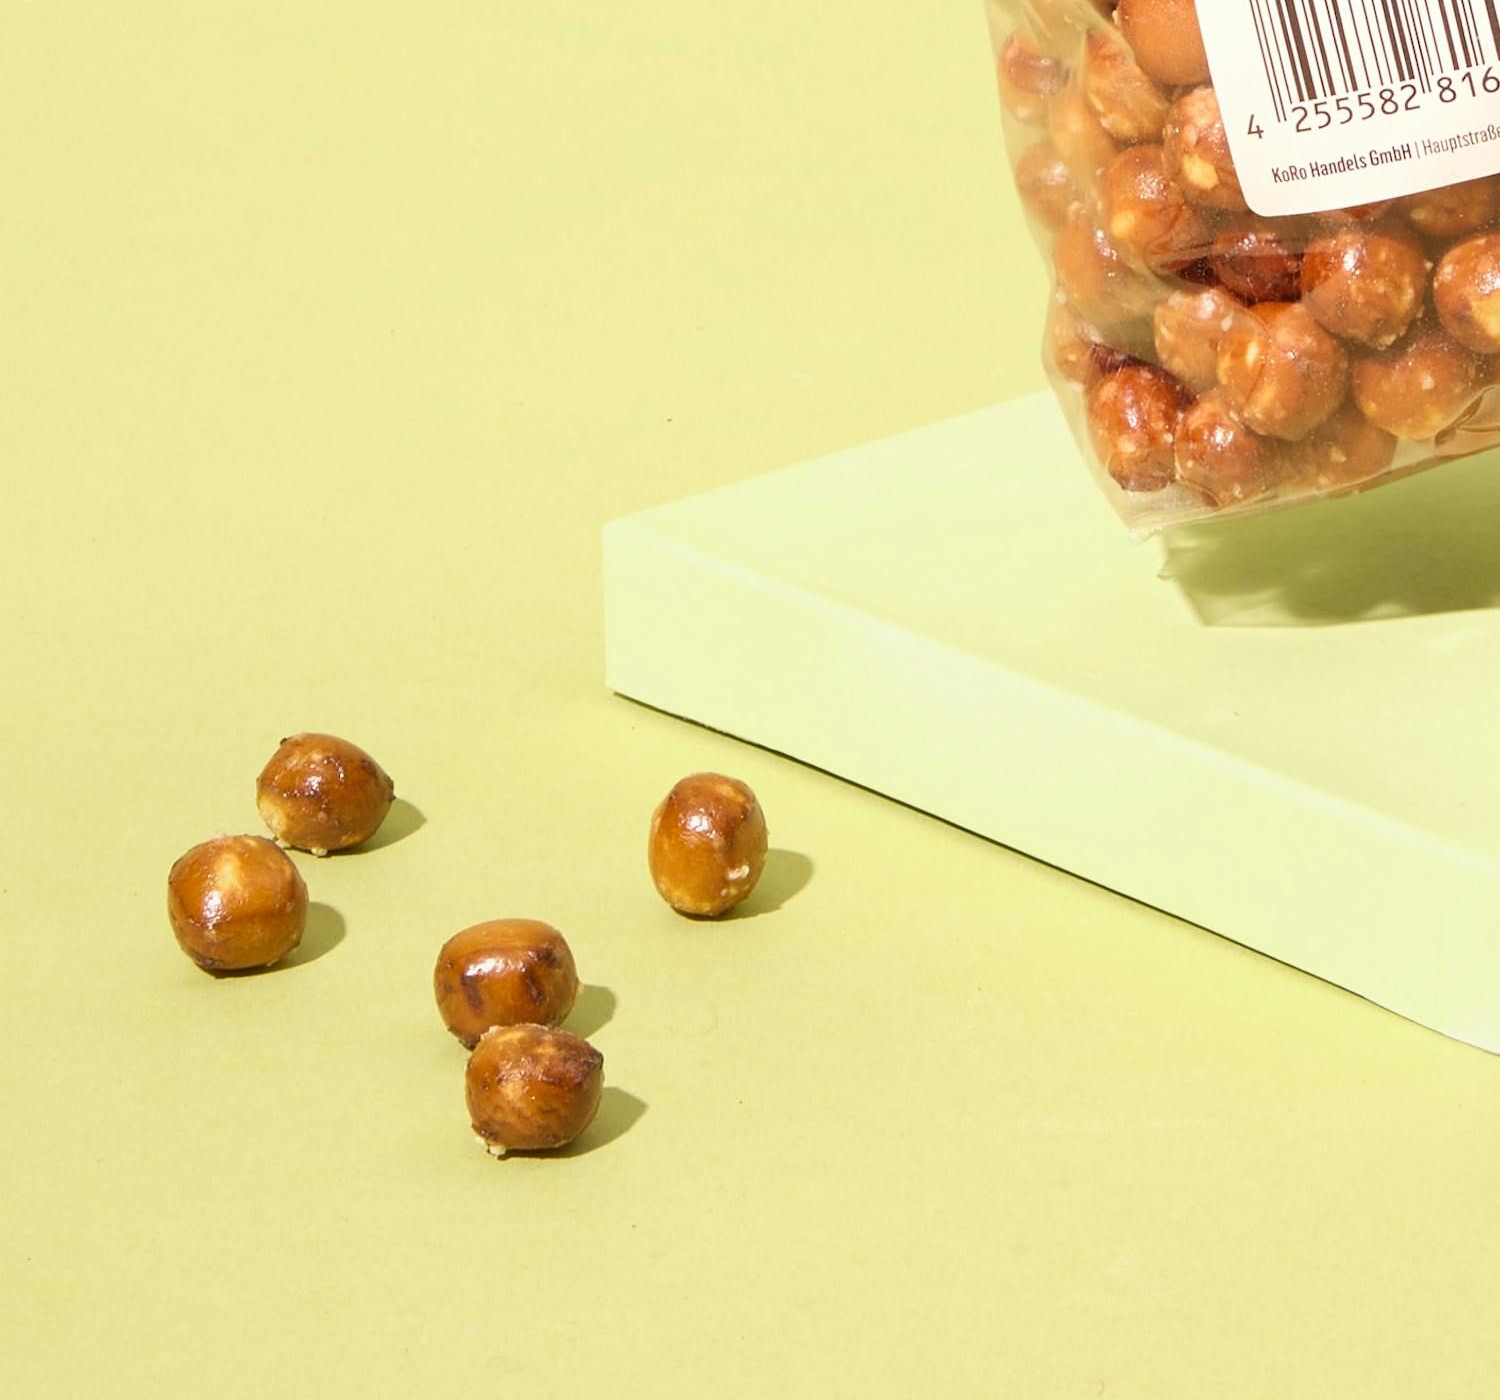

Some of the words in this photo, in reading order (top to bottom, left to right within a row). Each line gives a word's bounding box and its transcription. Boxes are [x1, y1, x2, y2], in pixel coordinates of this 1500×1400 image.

[1291, 78, 1421, 133] 255582
[1271, 164, 1308, 184] KoRo
[1308, 153, 1368, 178] Handels
[1368, 143, 1413, 167] GmbH
